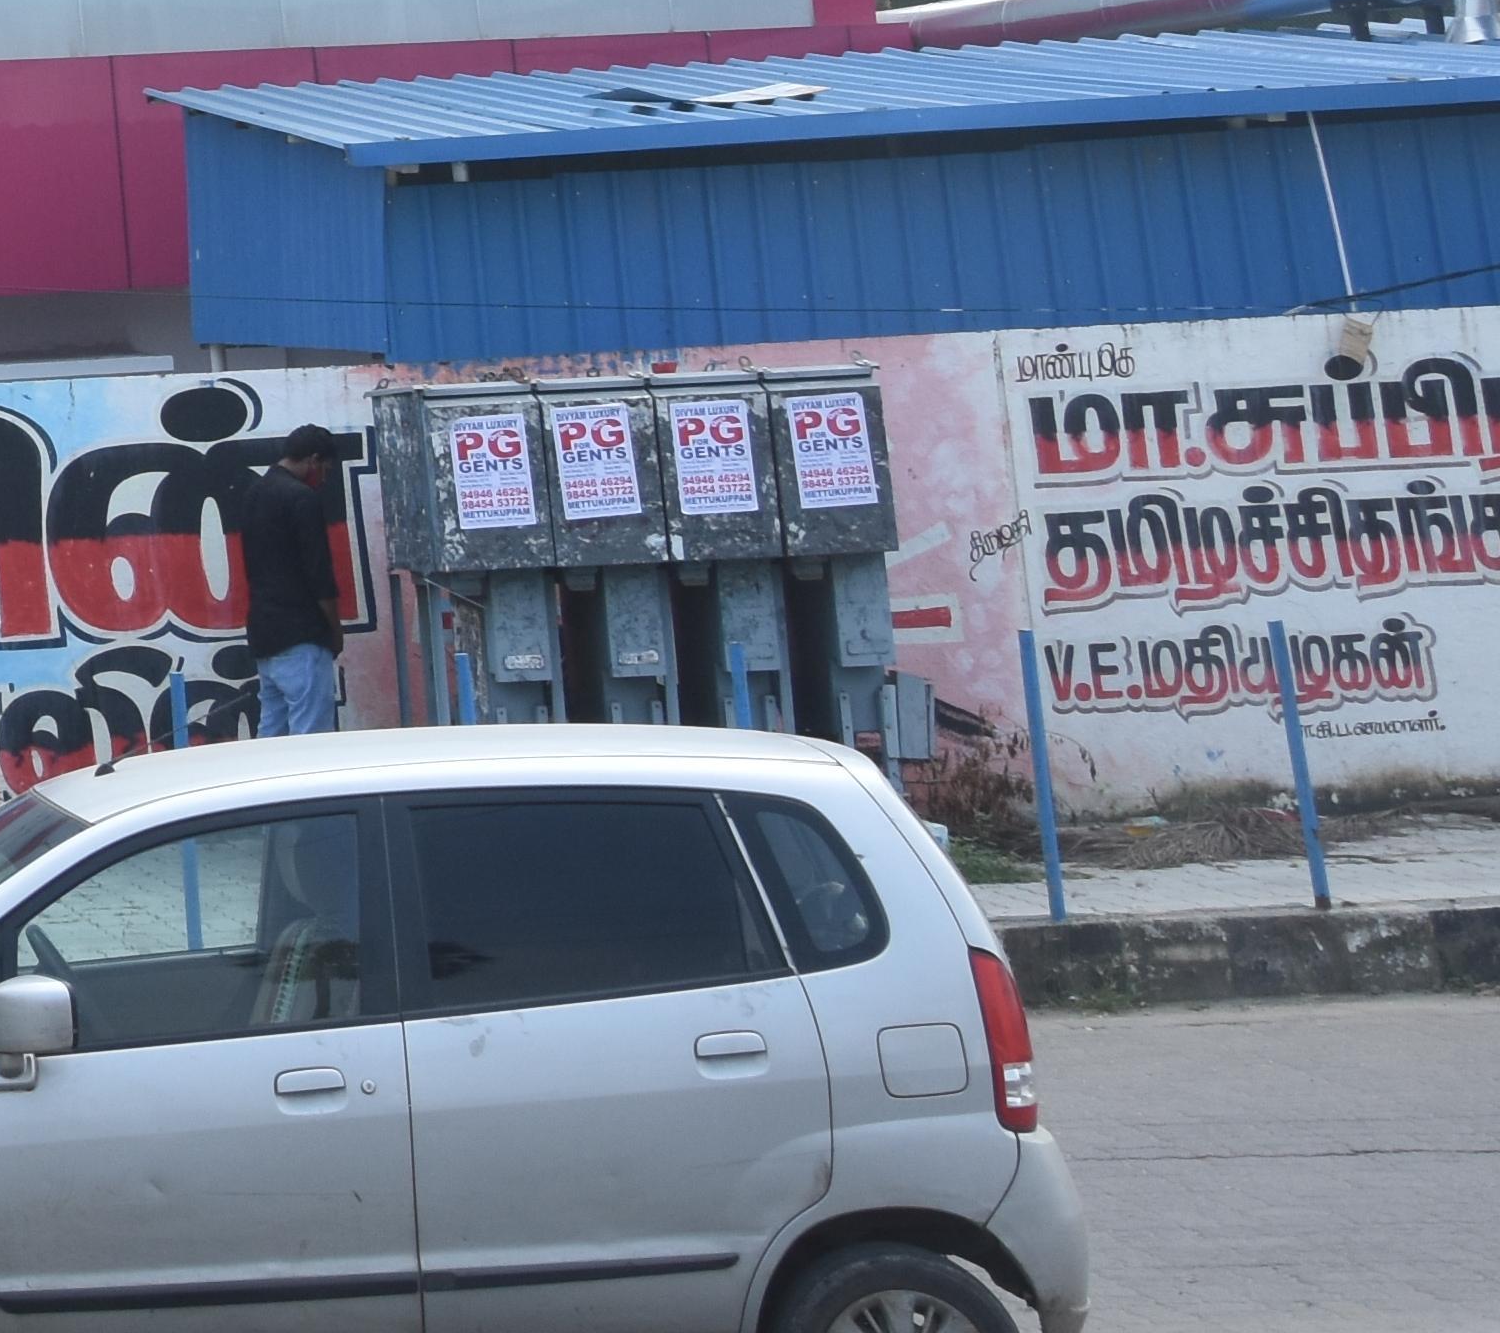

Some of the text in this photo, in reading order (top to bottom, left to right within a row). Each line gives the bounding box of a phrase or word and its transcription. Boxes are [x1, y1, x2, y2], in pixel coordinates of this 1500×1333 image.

[825, 398, 856, 408] LUXURY
[589, 408, 621, 419] LUXURY
[708, 405, 740, 415] LUXURY
[486, 419, 517, 429] LUXURY
[794, 408, 861, 440] PG
[558, 419, 625, 451] PG
[677, 415, 744, 446] PG
[455, 429, 522, 461] PG
[799, 436, 863, 453] GENTS
[470, 452, 487, 460] FOR
[562, 447, 627, 463] GENTS
[681, 444, 745, 459] GENTS
[459, 458, 523, 473] GENTS
[838, 476, 870, 486] 53722
[602, 487, 634, 497] 53722
[719, 483, 751, 493] 53722
[497, 497, 530, 507] 53722
